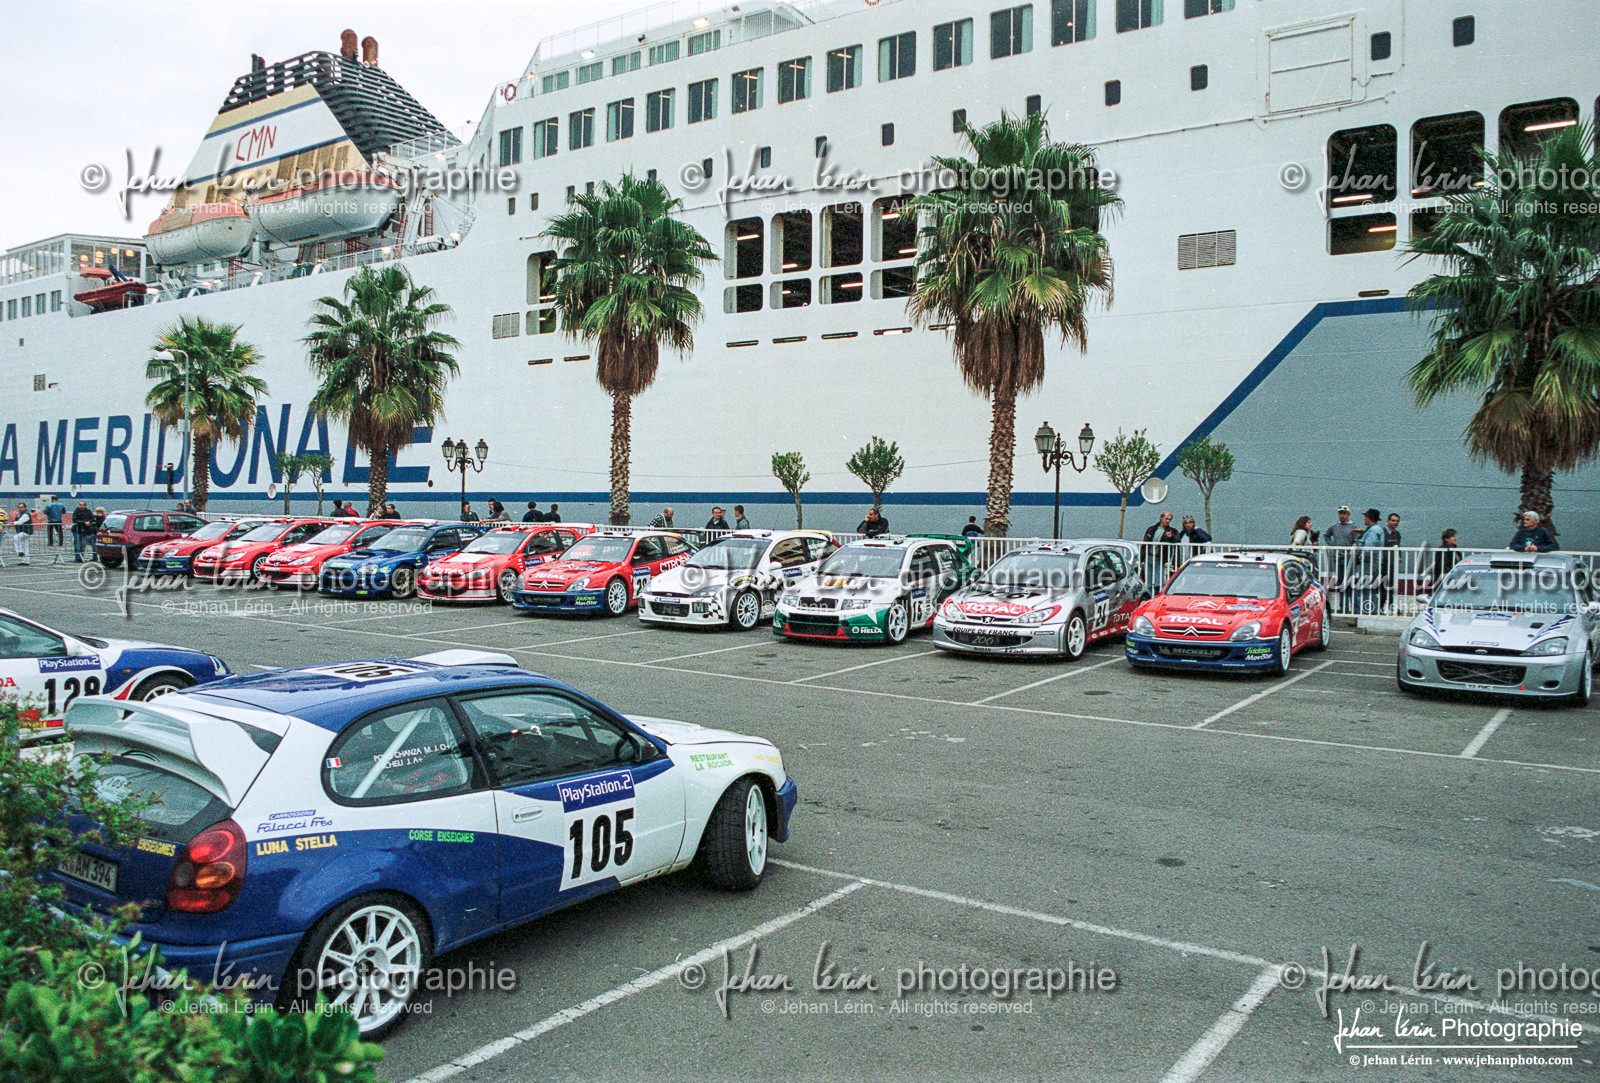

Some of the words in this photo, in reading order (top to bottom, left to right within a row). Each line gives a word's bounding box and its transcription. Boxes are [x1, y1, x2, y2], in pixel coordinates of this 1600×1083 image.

[236, 125, 277, 162] CMN
[965, 602, 1020, 614] TOTAL
[1168, 615, 1223, 625] TOTAL
[690, 752, 728, 763] RESTAURANT
[695, 762, 704, 771] LA
[409, 829, 433, 841] CORSE
[437, 831, 475, 843] ENSEIGNES
[256, 840, 289, 856] LUNA
[295, 834, 338, 851] STELLA
[569, 807, 634, 880] 105
